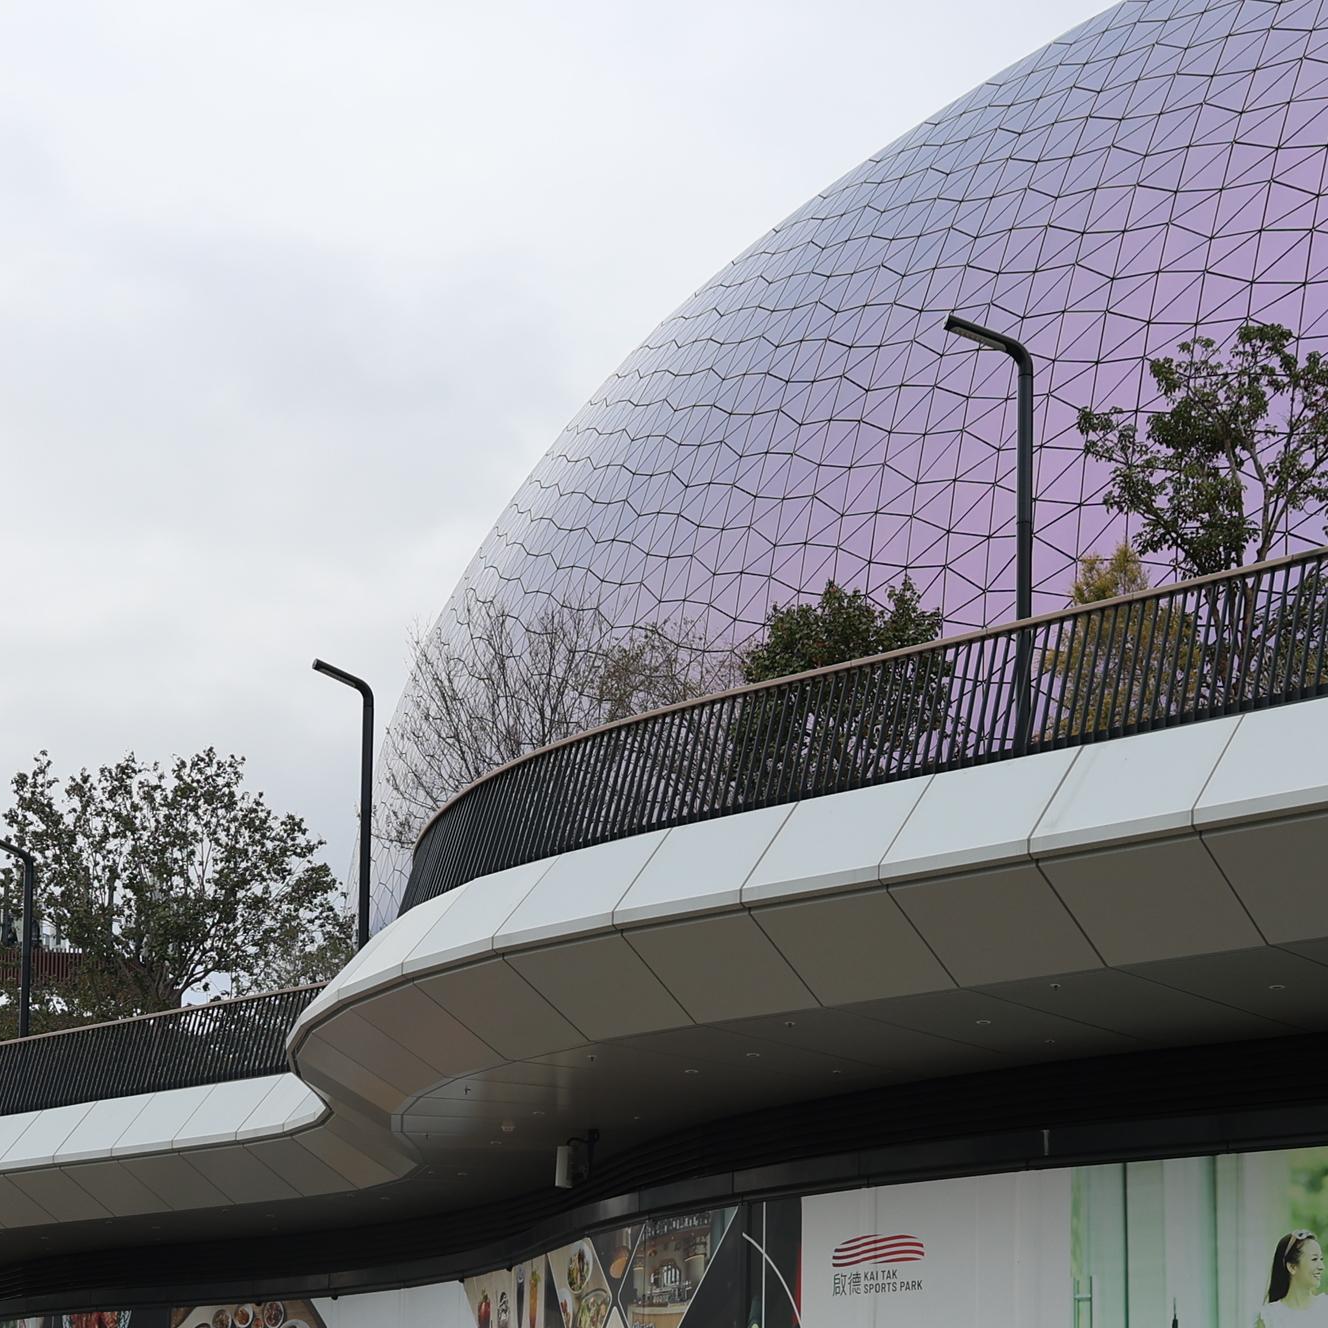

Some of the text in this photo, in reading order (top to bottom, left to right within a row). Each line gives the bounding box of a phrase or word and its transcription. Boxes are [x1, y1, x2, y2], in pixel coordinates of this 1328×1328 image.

[863, 1269, 898, 1282] KAI TAK
[832, 1272, 861, 1296] 啟德
[863, 1280, 923, 1294] SPORTS PARK
